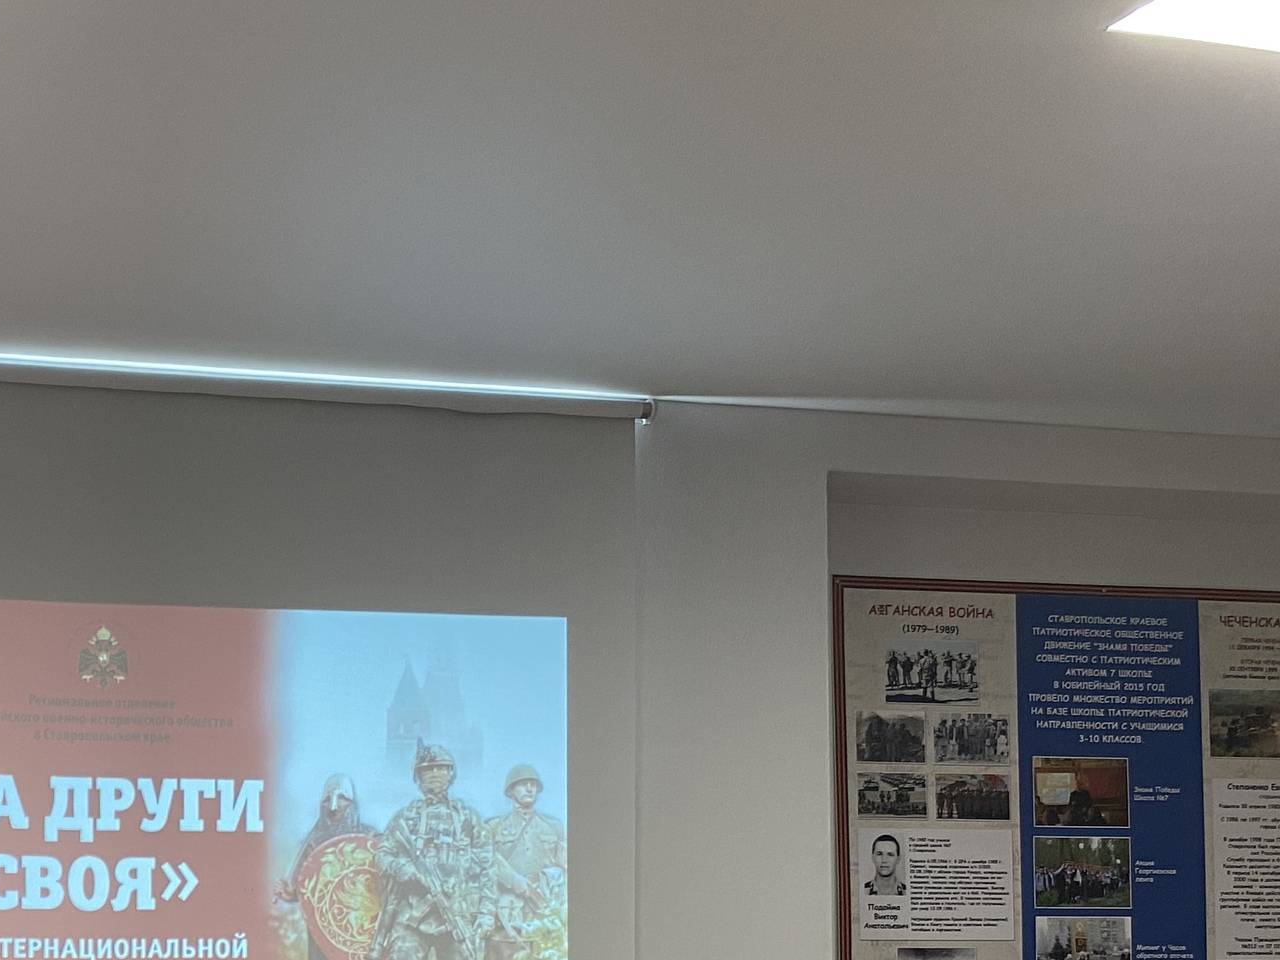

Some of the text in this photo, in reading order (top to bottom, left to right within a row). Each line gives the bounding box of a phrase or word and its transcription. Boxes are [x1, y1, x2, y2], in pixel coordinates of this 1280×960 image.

[949, 604, 994, 618] ВОЙНА
[1048, 615, 1168, 626] СТАВРОПОЛЬСКОЕ КРАЕВОЕ
[1032, 628, 1184, 640] ПАТРИОТИЧЕСКОЕ ОБЩЕСТВЕННОЕ
[1044, 641, 1090, 650] ДВИЖЕНИЕ
[1036, 654, 1088, 664] СОВМЕСТНО
[1100, 656, 1181, 666] ПАТРИОТИЧЕСКИМ
[1065, 669, 1106, 677] АКТИВОМ
[1118, 670, 1152, 678] ШКОЛЫ
[1062, 680, 1120, 691] ЮБИЛЕЙНЫЙ
[1147, 684, 1165, 692] ГОД
[1028, 694, 1194, 705] ПРОВЕЛО МНОЖЕСТВО МЕРОПРИЯТИЙ
[1108, 708, 1188, 718] ПАТРИОТИЧЕСКОЙ
[1036, 720, 1118, 730] НАПРАВЛЕННОСТИ
[1130, 722, 1184, 732] УЧАЩИМИСЯ
[44, 776, 264, 843] ДРУГИ
